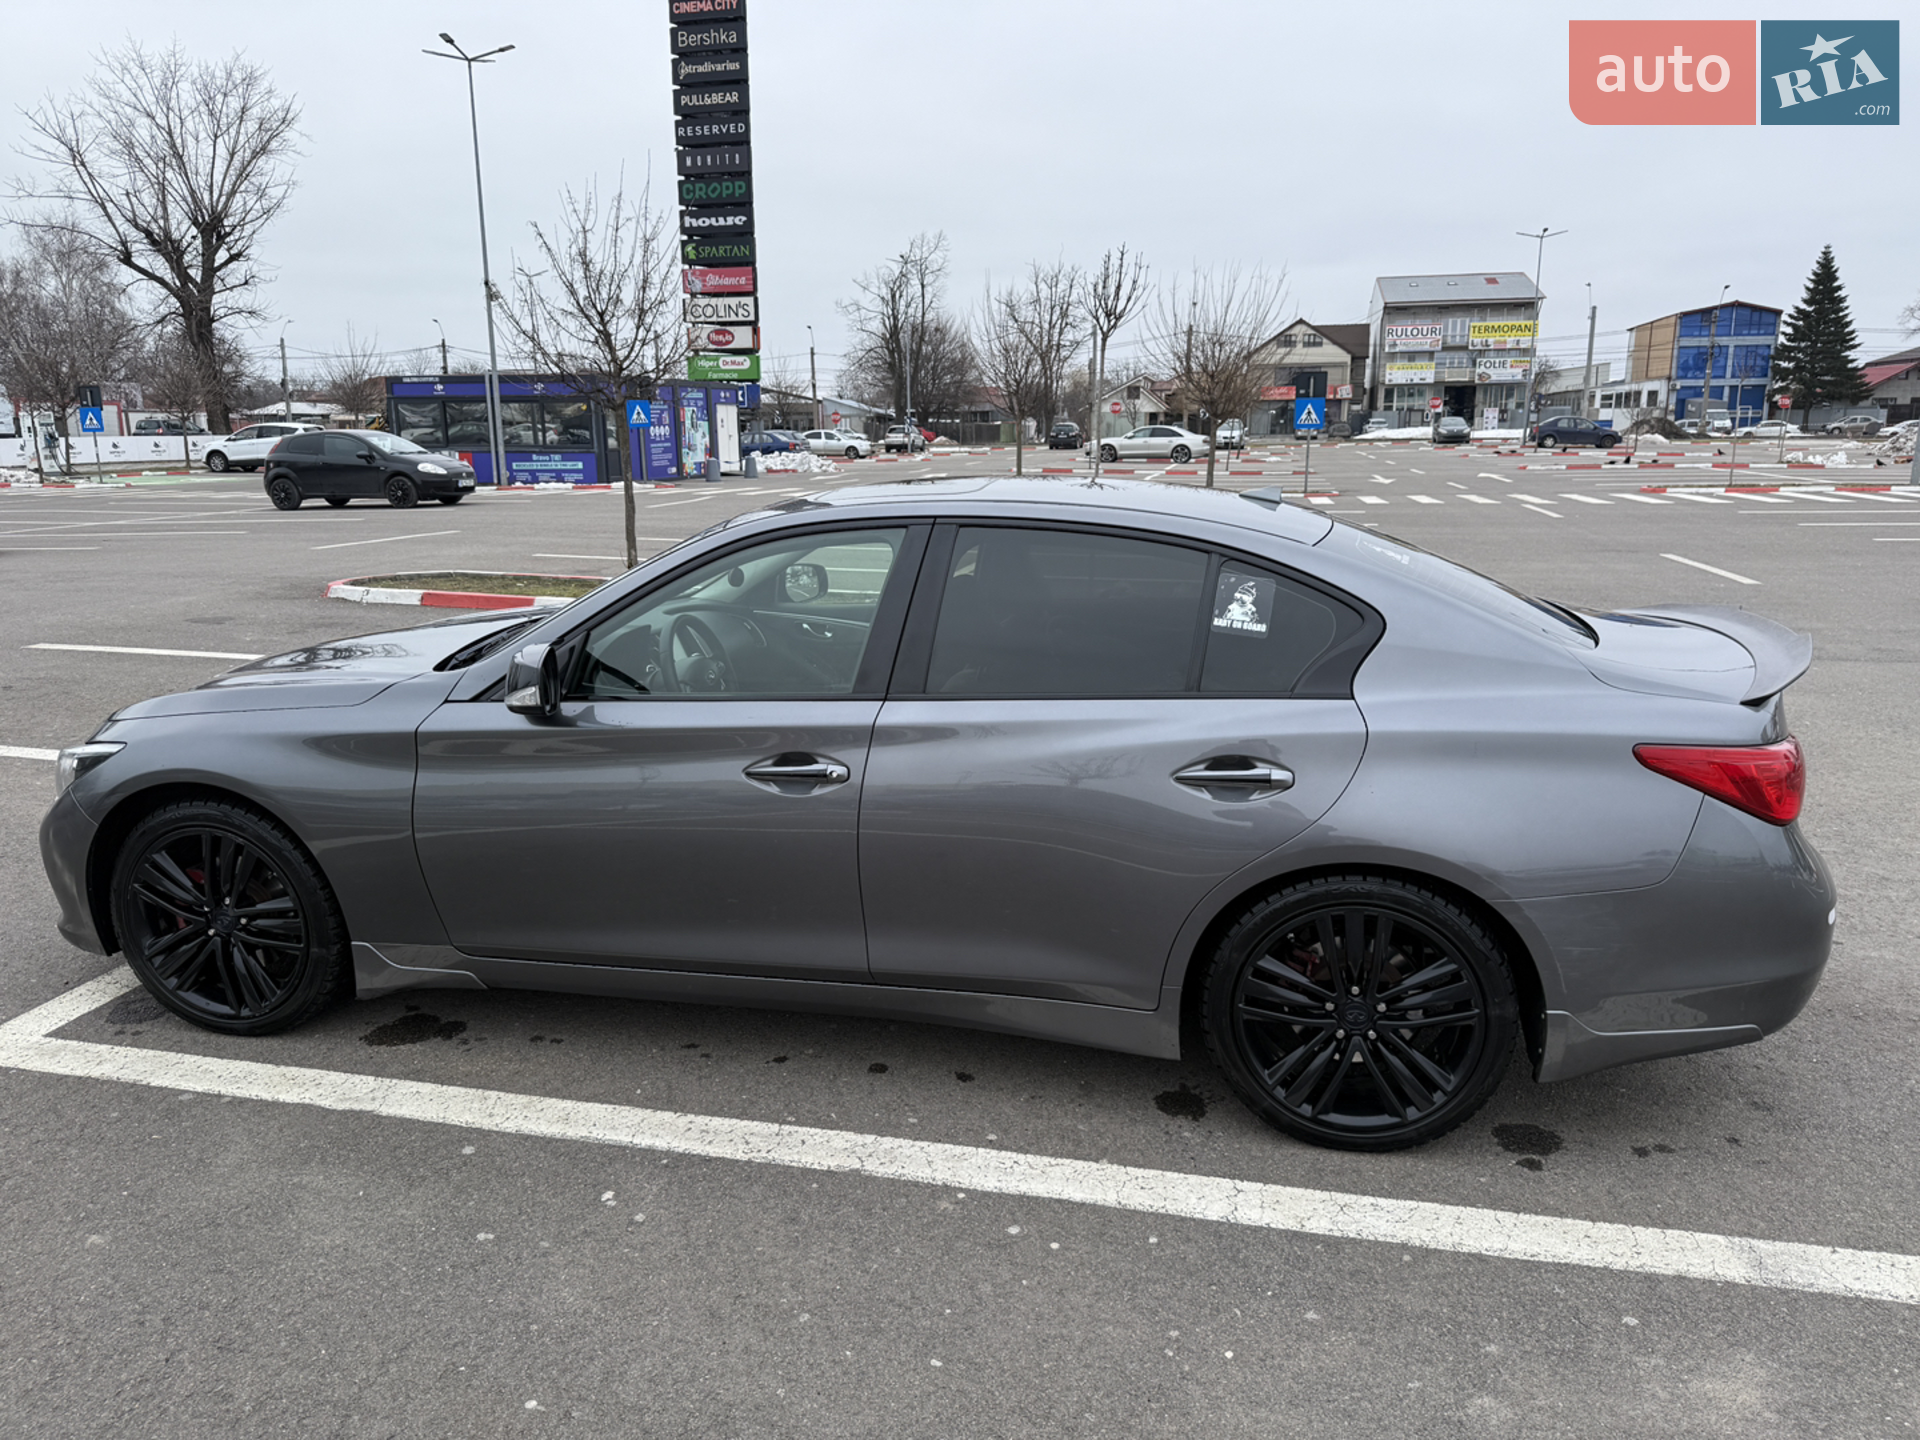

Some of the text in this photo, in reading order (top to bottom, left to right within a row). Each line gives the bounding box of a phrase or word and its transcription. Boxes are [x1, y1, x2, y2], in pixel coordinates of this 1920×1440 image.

[673, 0, 738, 14] CINEMA CITY
[677, 28, 738, 48] Bershka
[681, 92, 740, 106] PULL&BEAR
[678, 123, 746, 137] RESERVED
[686, 153, 740, 167] MOHITO
[682, 181, 747, 200] CROPP
[684, 215, 748, 228] house
[698, 244, 750, 258] SPARTAN
[690, 301, 751, 319] COLIN'S
[1387, 326, 1442, 338] RULOURI
[1471, 324, 1532, 334] TERMOPAN
[698, 359, 718, 368] Hiper
[1478, 359, 1508, 369] FOLIE
[708, 371, 738, 379] Farmacie
